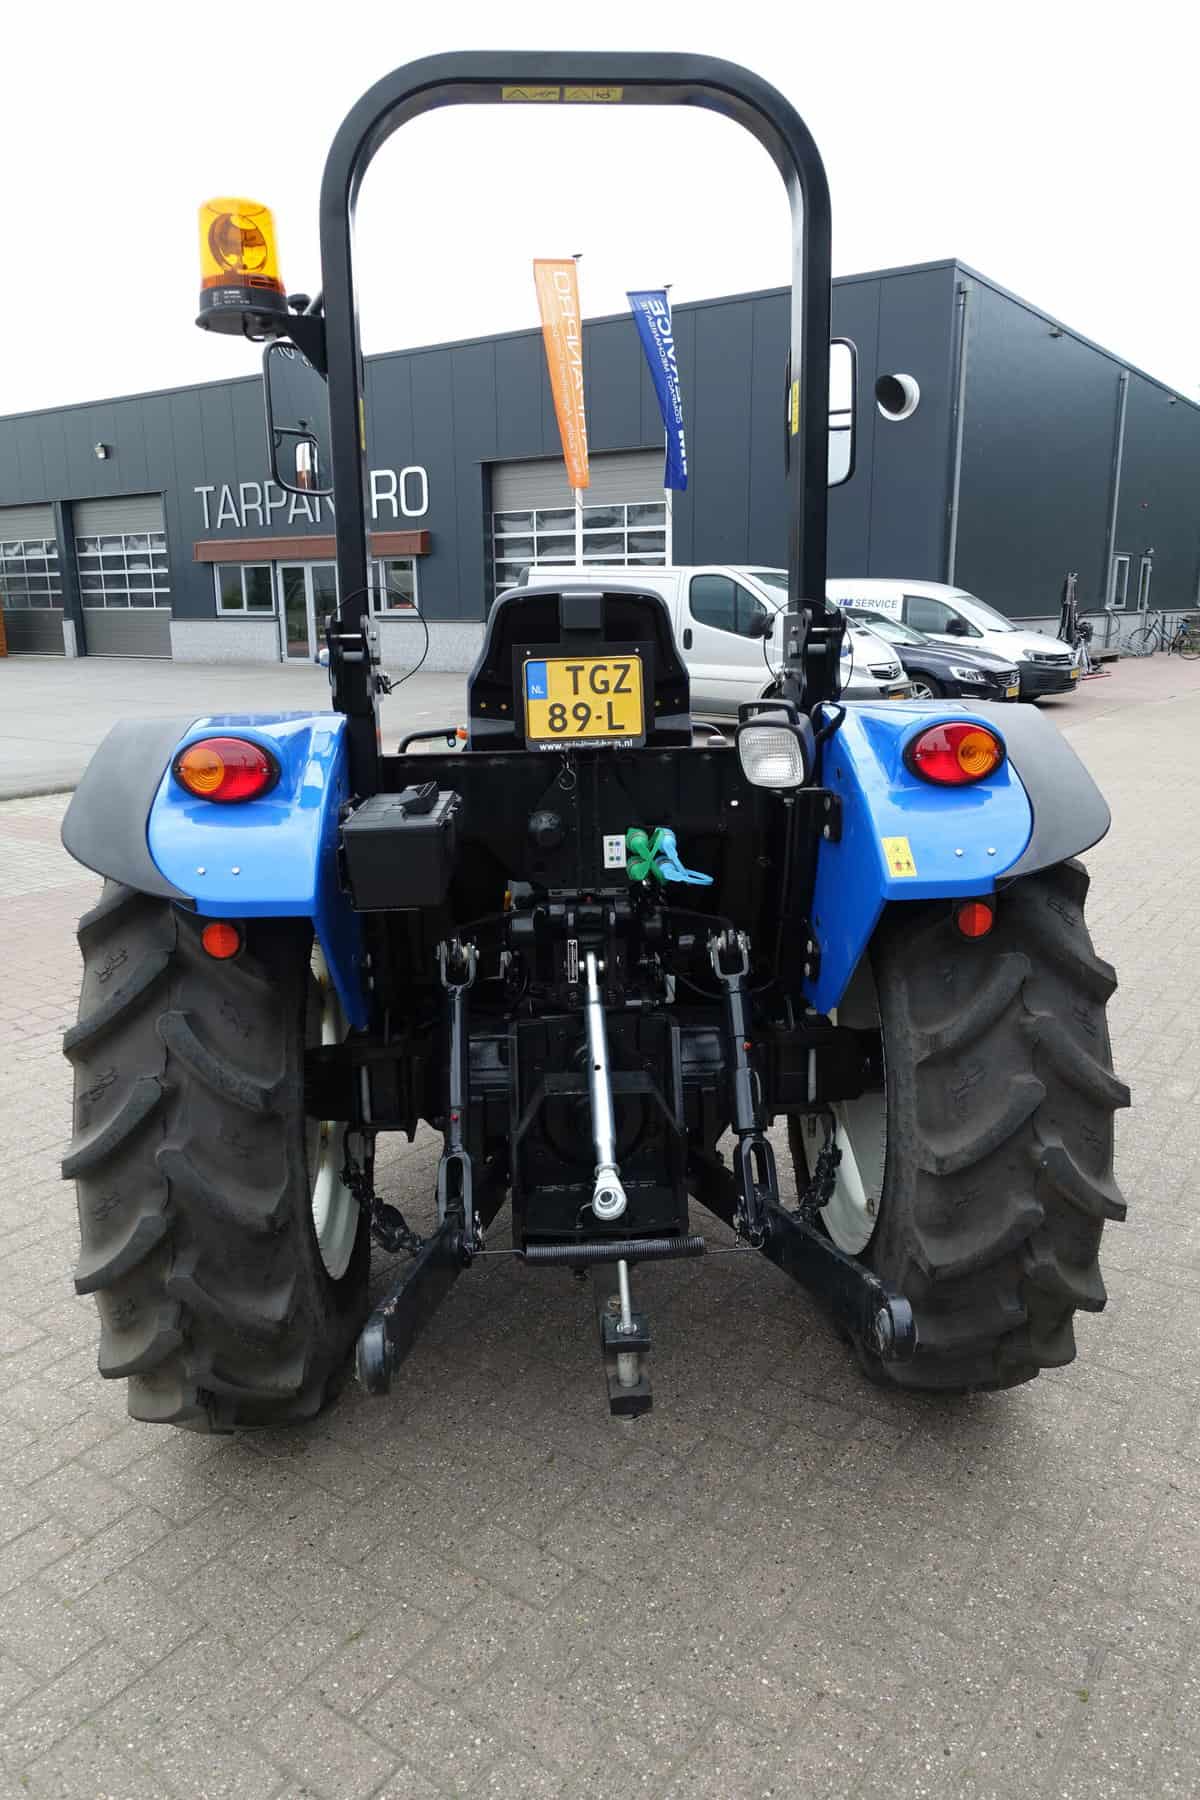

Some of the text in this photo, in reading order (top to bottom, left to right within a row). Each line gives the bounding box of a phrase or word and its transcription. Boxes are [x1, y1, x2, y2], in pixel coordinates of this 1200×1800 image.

[194, 466, 429, 529] TARPANRO
[854, 598, 897, 609] SERVICE
[531, 685, 544, 695] NL
[565, 664, 632, 695] TGZ
[548, 701, 625, 733] 89-L
